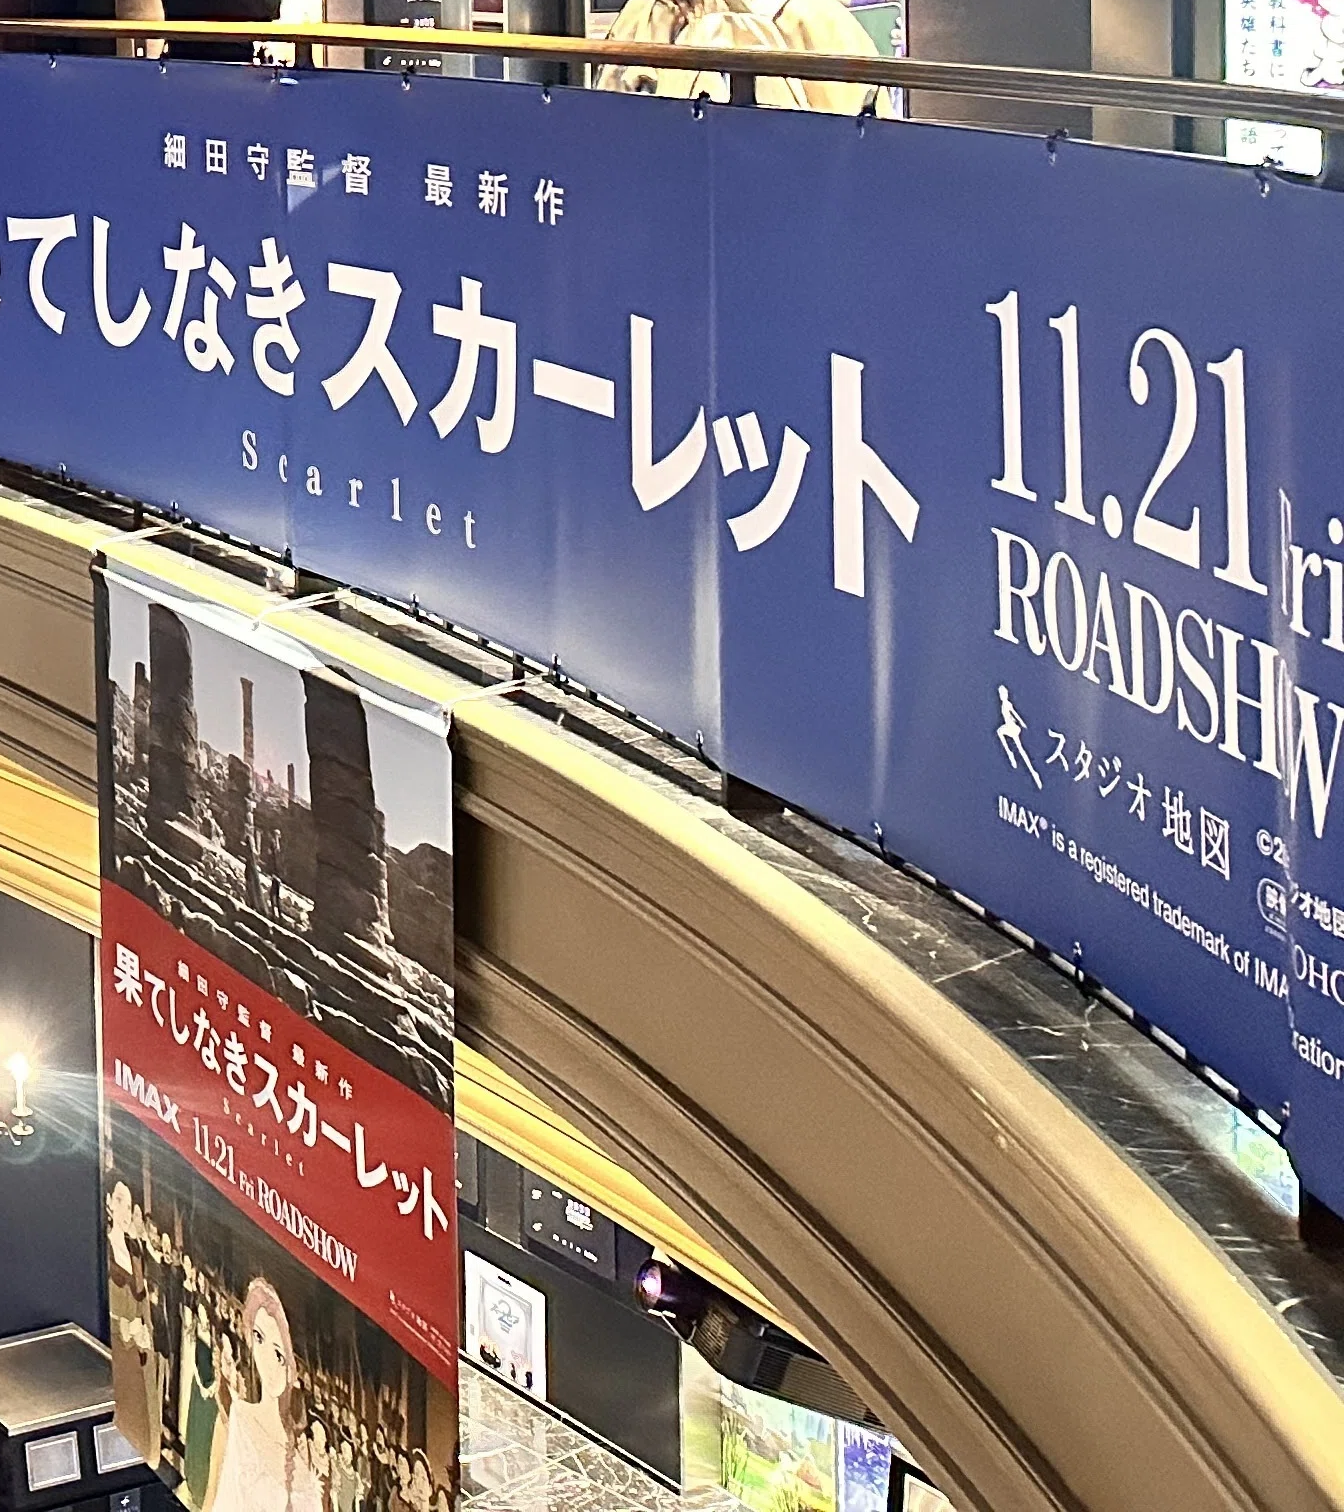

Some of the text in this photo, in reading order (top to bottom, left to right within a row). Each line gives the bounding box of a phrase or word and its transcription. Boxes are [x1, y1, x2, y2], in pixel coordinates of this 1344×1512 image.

[163, 132, 566, 226] 細田守監督 最新作
[241, 429, 479, 549] Scarlet
[985, 290, 1269, 598] 11.21
[991, 527, 1344, 838] ROADSHW
[1045, 729, 1230, 881] スタジオ地図
[1052, 823, 1065, 853] is
[1068, 839, 1078, 861] a
[1080, 848, 1150, 910] registered
[1152, 890, 1230, 965] trademark
[1234, 951, 1250, 978] of
[1254, 958, 1290, 999] IMA
[113, 942, 448, 1241] 果てしなきスカーレット
[114, 1058, 359, 1283] IMAX 11.21 Fri ROADSHOW
[222, 1097, 305, 1177] Scarlet
